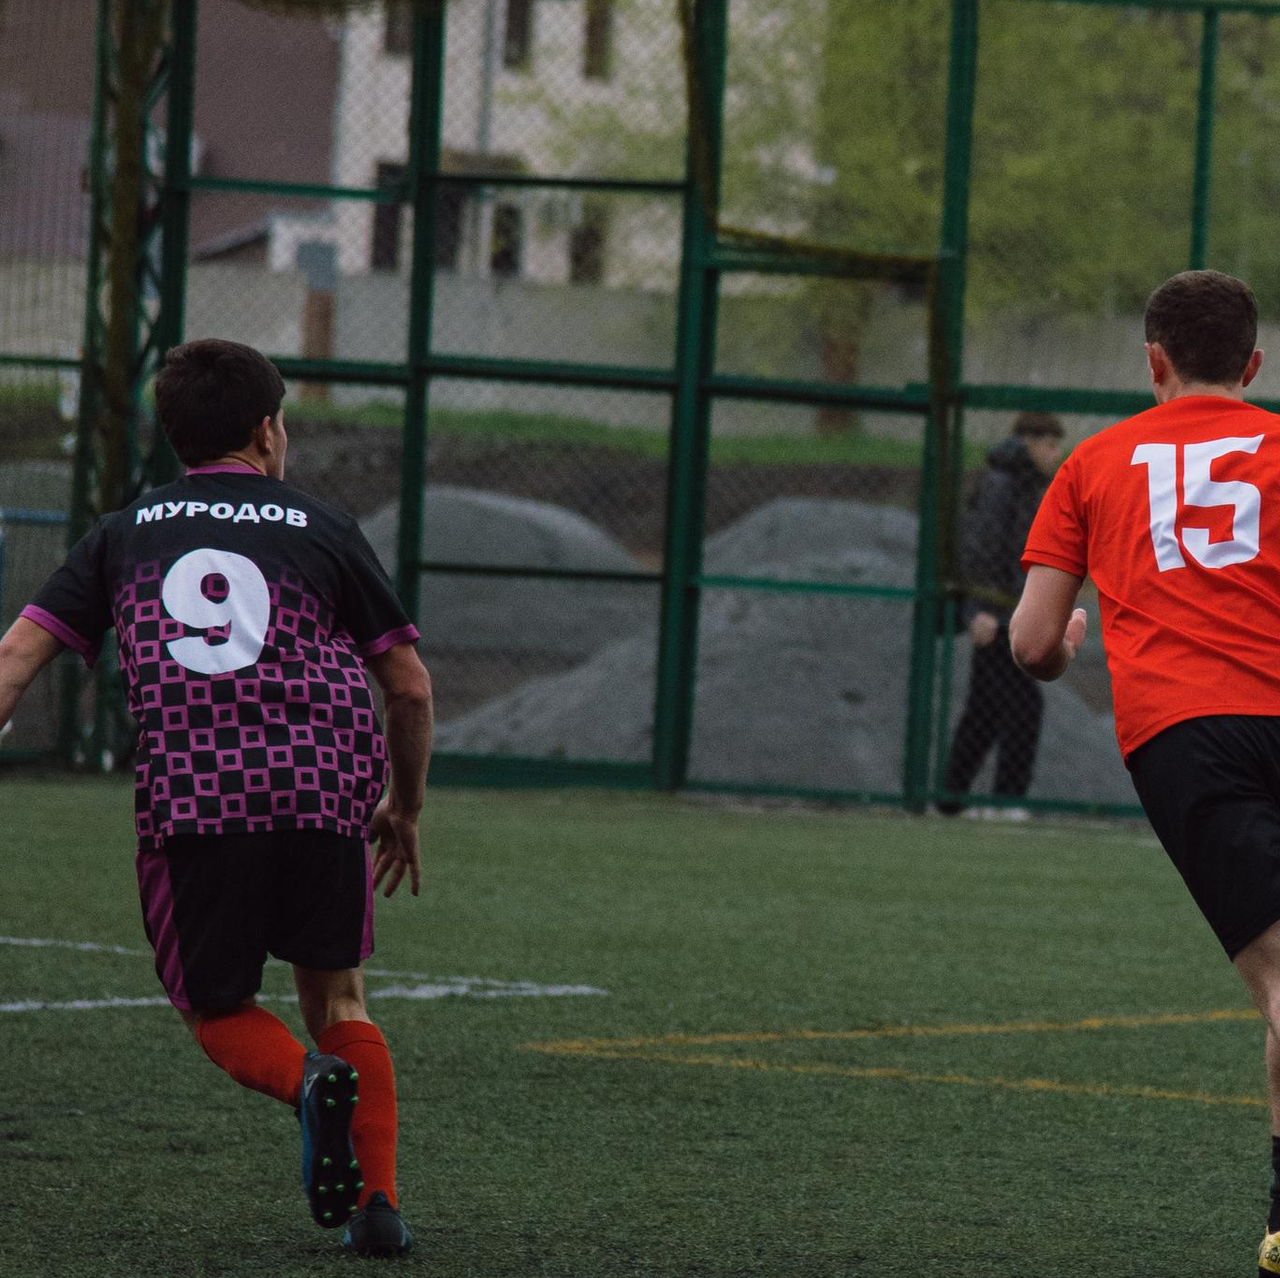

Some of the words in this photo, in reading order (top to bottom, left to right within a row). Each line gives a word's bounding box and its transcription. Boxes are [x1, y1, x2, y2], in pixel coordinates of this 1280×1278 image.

[136, 501, 308, 528] МУРОДОВ
[1130, 433, 1266, 573] 15
[162, 548, 271, 675] 9
